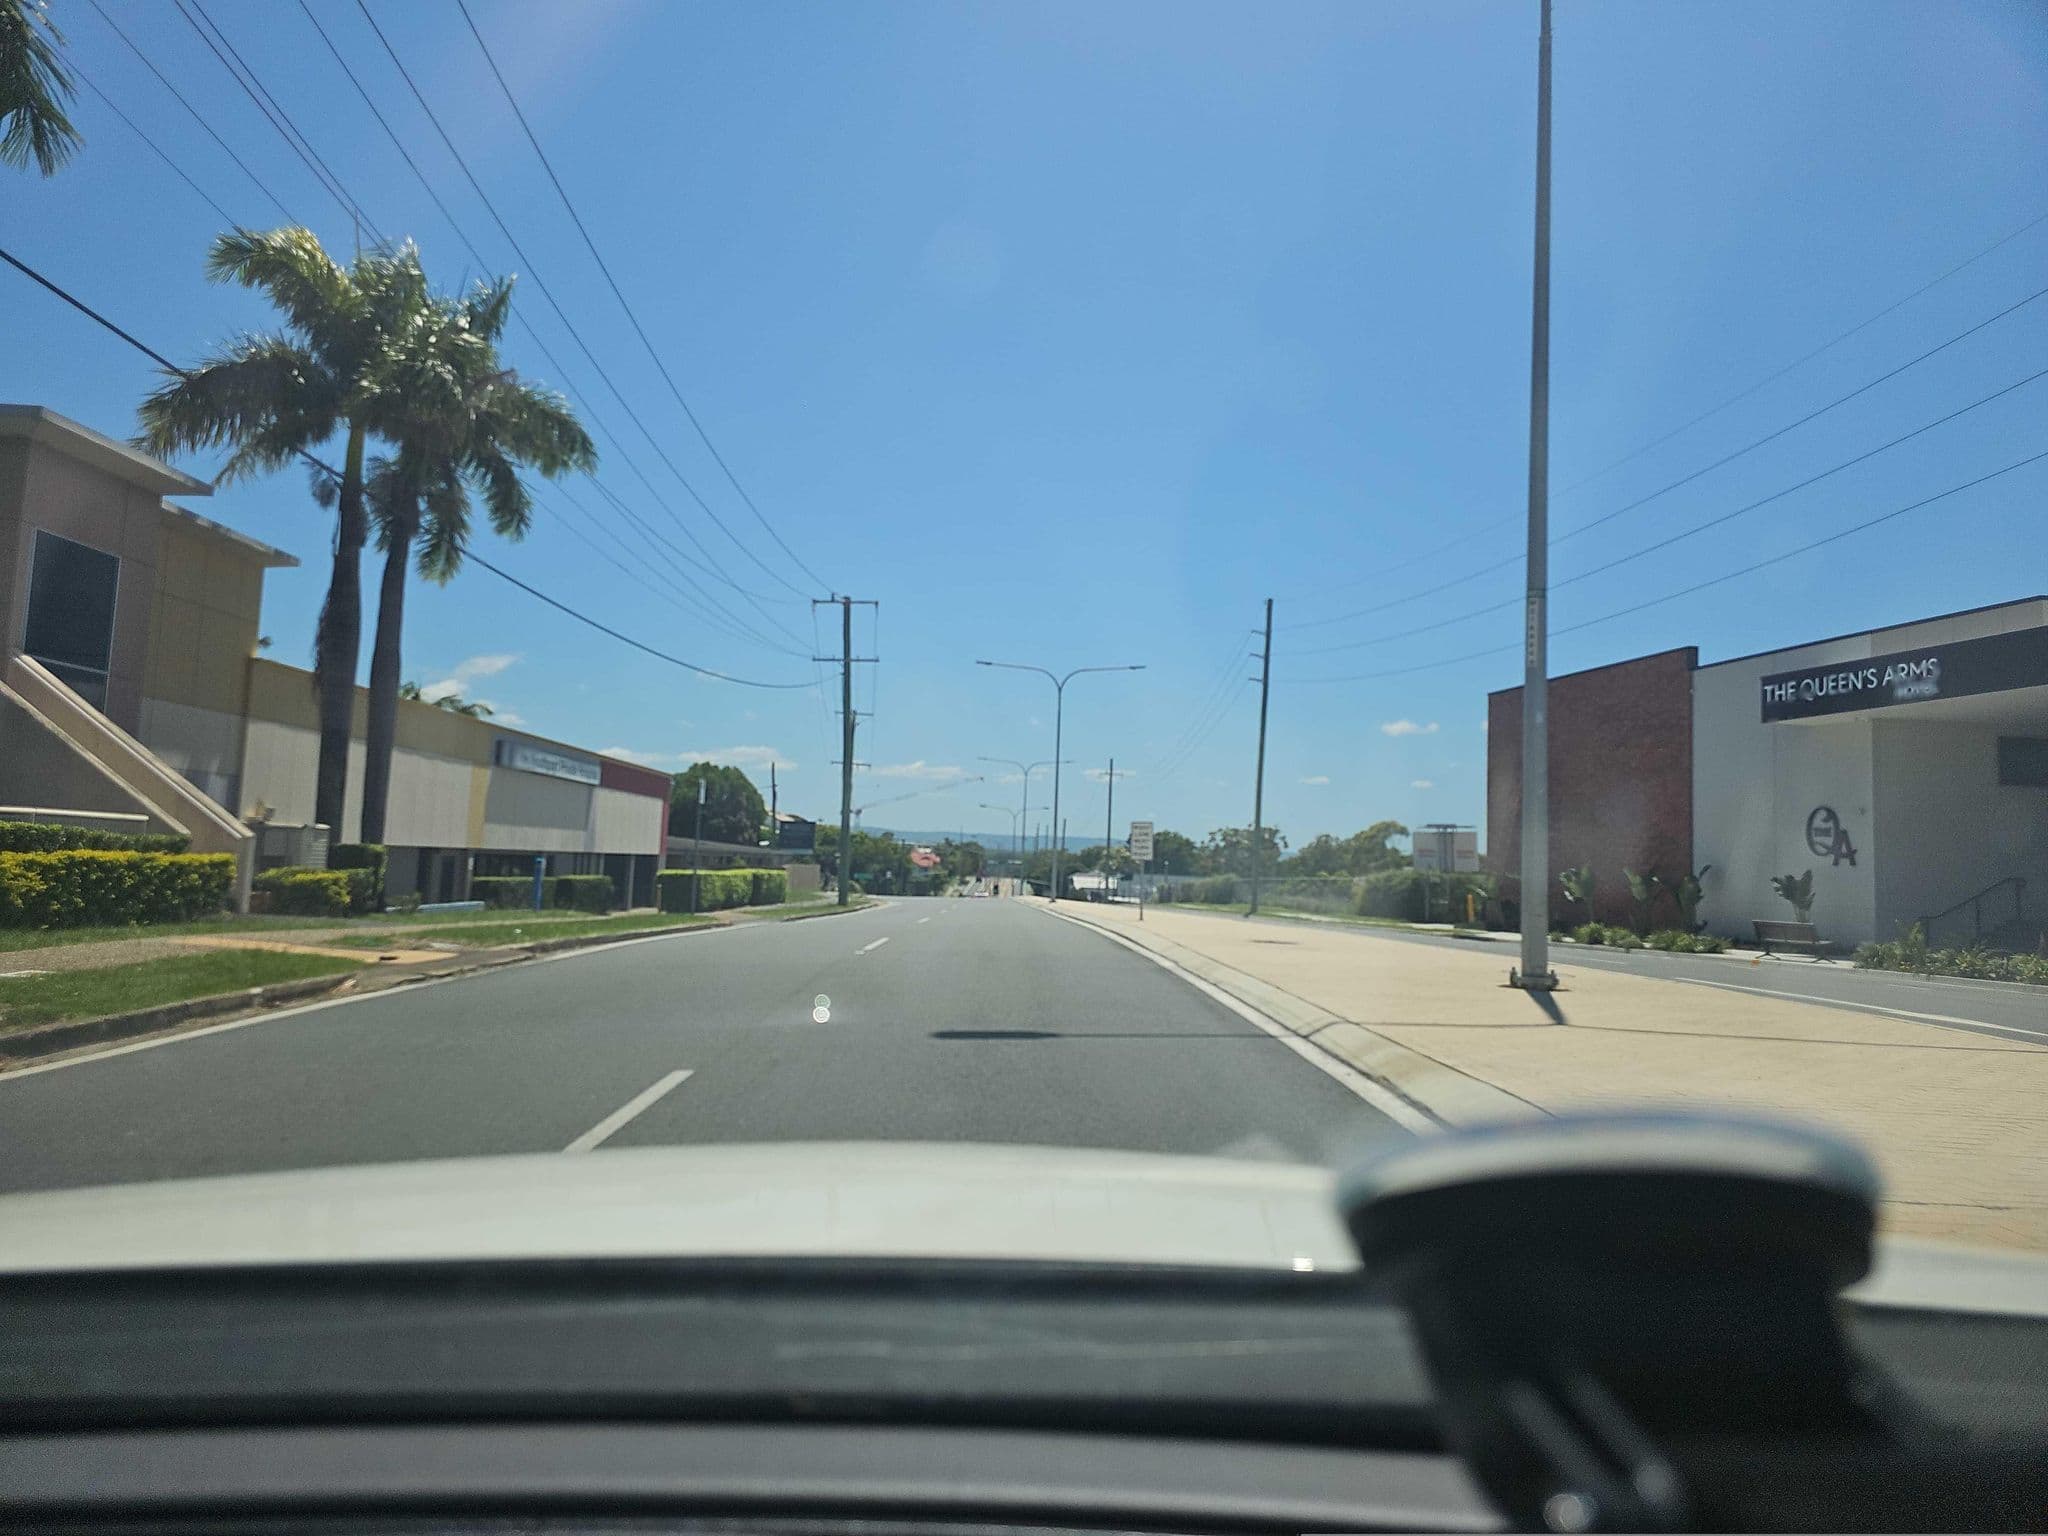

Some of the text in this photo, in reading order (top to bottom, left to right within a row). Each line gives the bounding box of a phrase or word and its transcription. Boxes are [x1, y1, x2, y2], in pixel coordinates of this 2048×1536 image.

[1764, 681, 1796, 703] THE
[1801, 668, 1878, 701] QUEEN'S
[1882, 658, 1938, 687] ARMS
